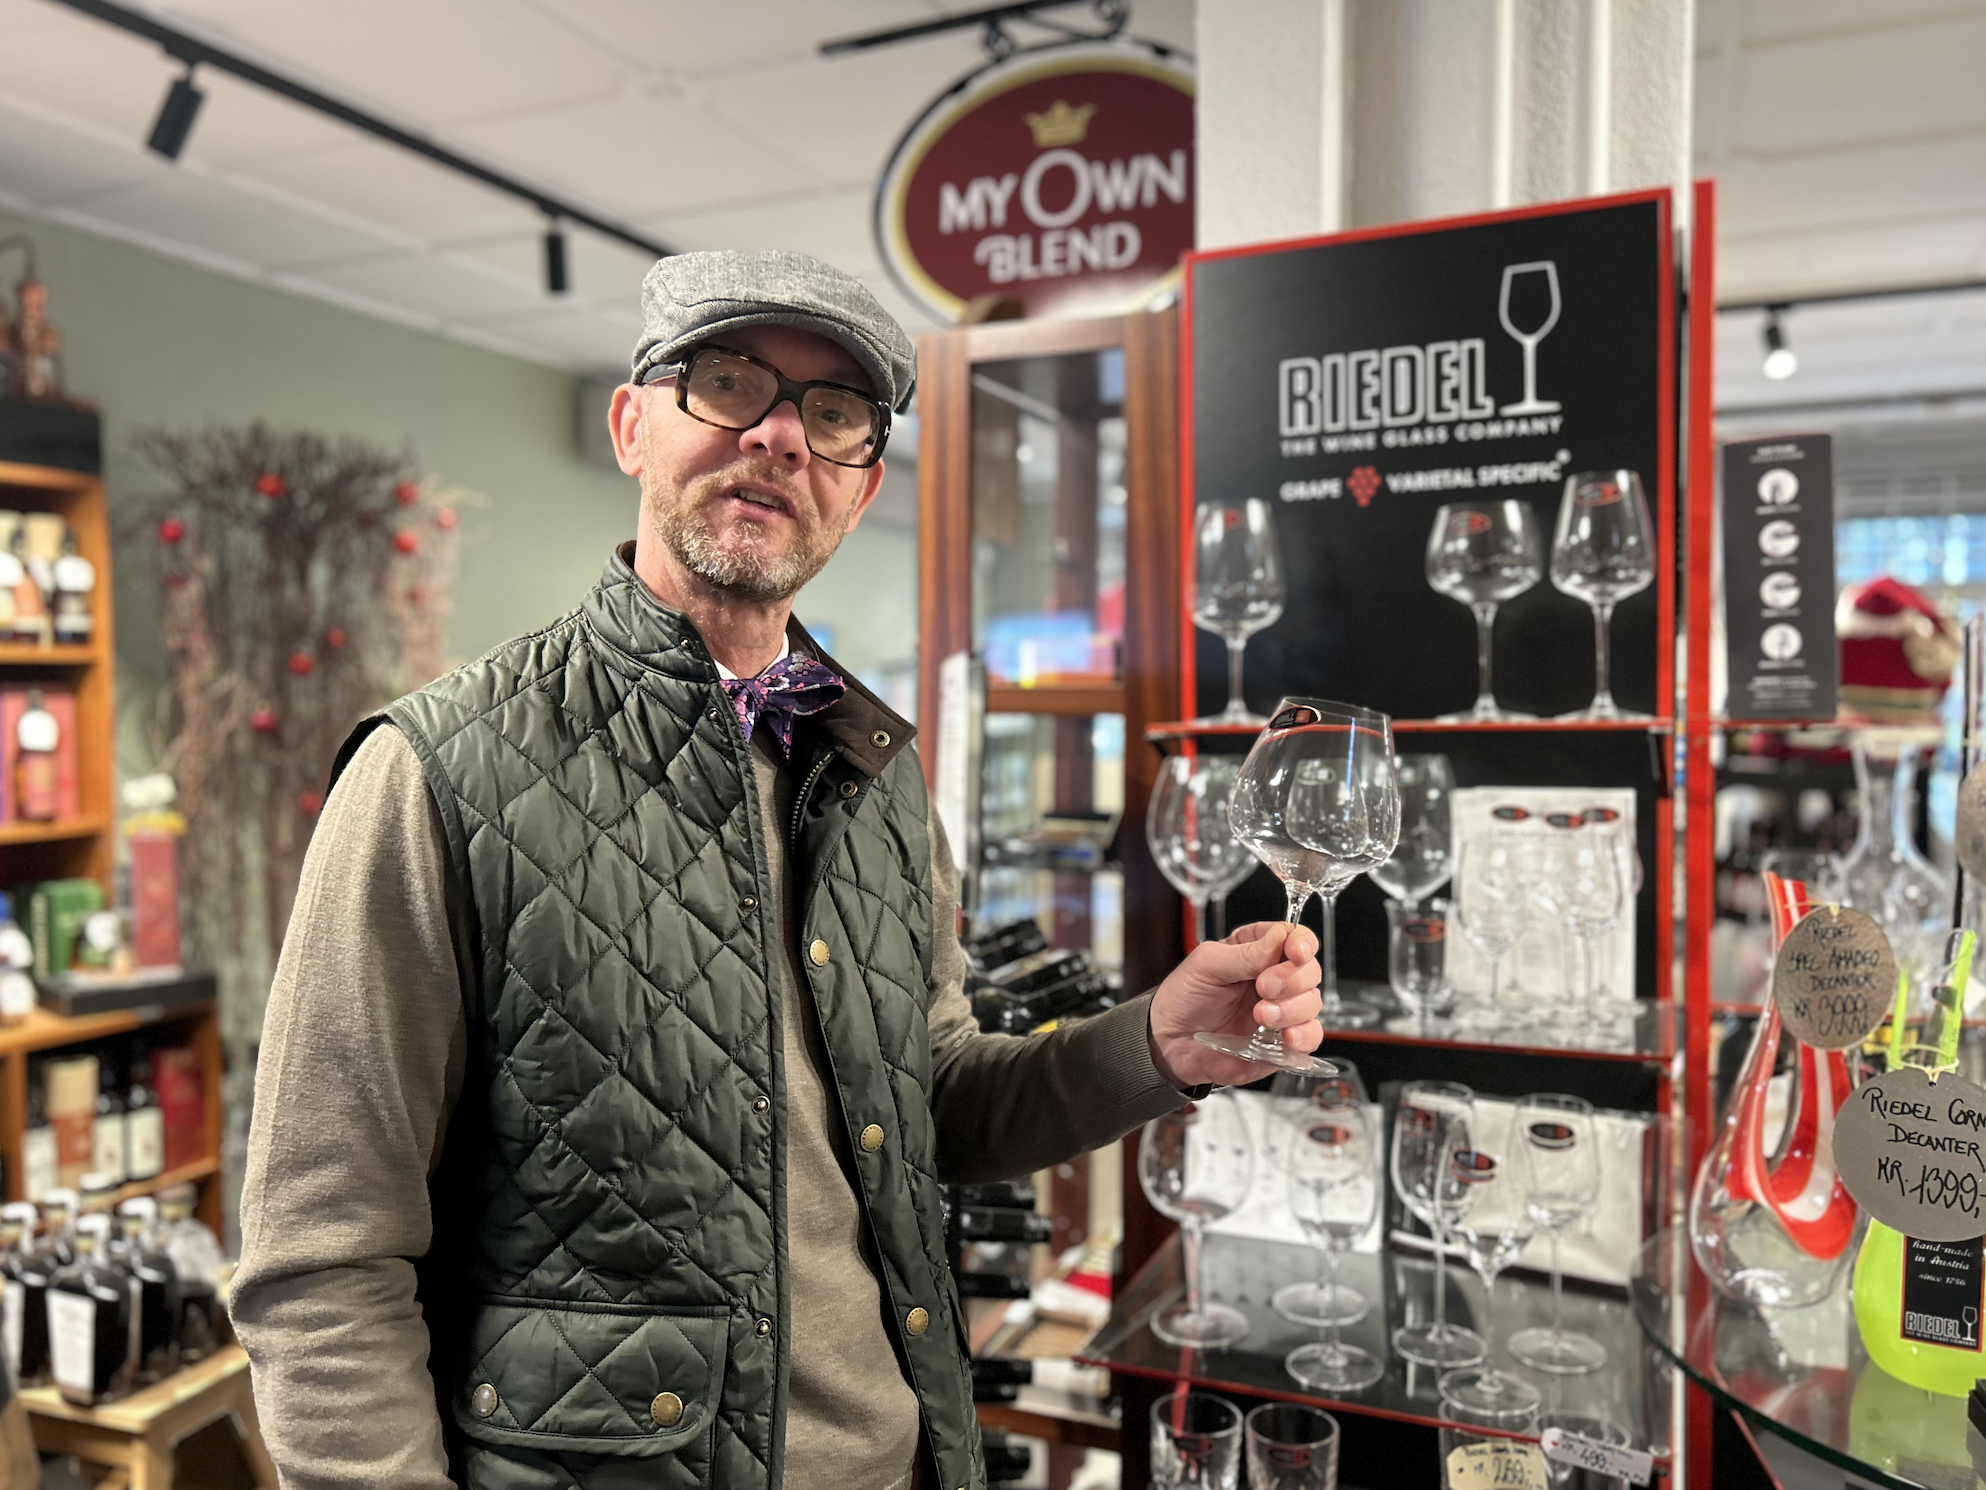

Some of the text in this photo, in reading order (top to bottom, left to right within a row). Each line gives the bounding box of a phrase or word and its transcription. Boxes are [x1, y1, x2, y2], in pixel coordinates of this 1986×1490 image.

[938, 149, 1187, 235] MY OWN
[973, 220, 1142, 284] BLEND
[1278, 337, 1495, 437] RIEDEL
[1280, 415, 1563, 457] THE WINE GLASS COMPANY
[1279, 477, 1342, 502] GRAPE
[1385, 467, 1476, 493] VARIETAL
[1862, 1087, 1937, 1121] RIEDEL
[1887, 1123, 1986, 1173] DECANTER
[1912, 1240, 1974, 1258] hand-made
[1914, 1253, 1970, 1270] in Austria
[1918, 1273, 1966, 1286] since 1756
[1905, 1311, 1960, 1339] RIEDEL
